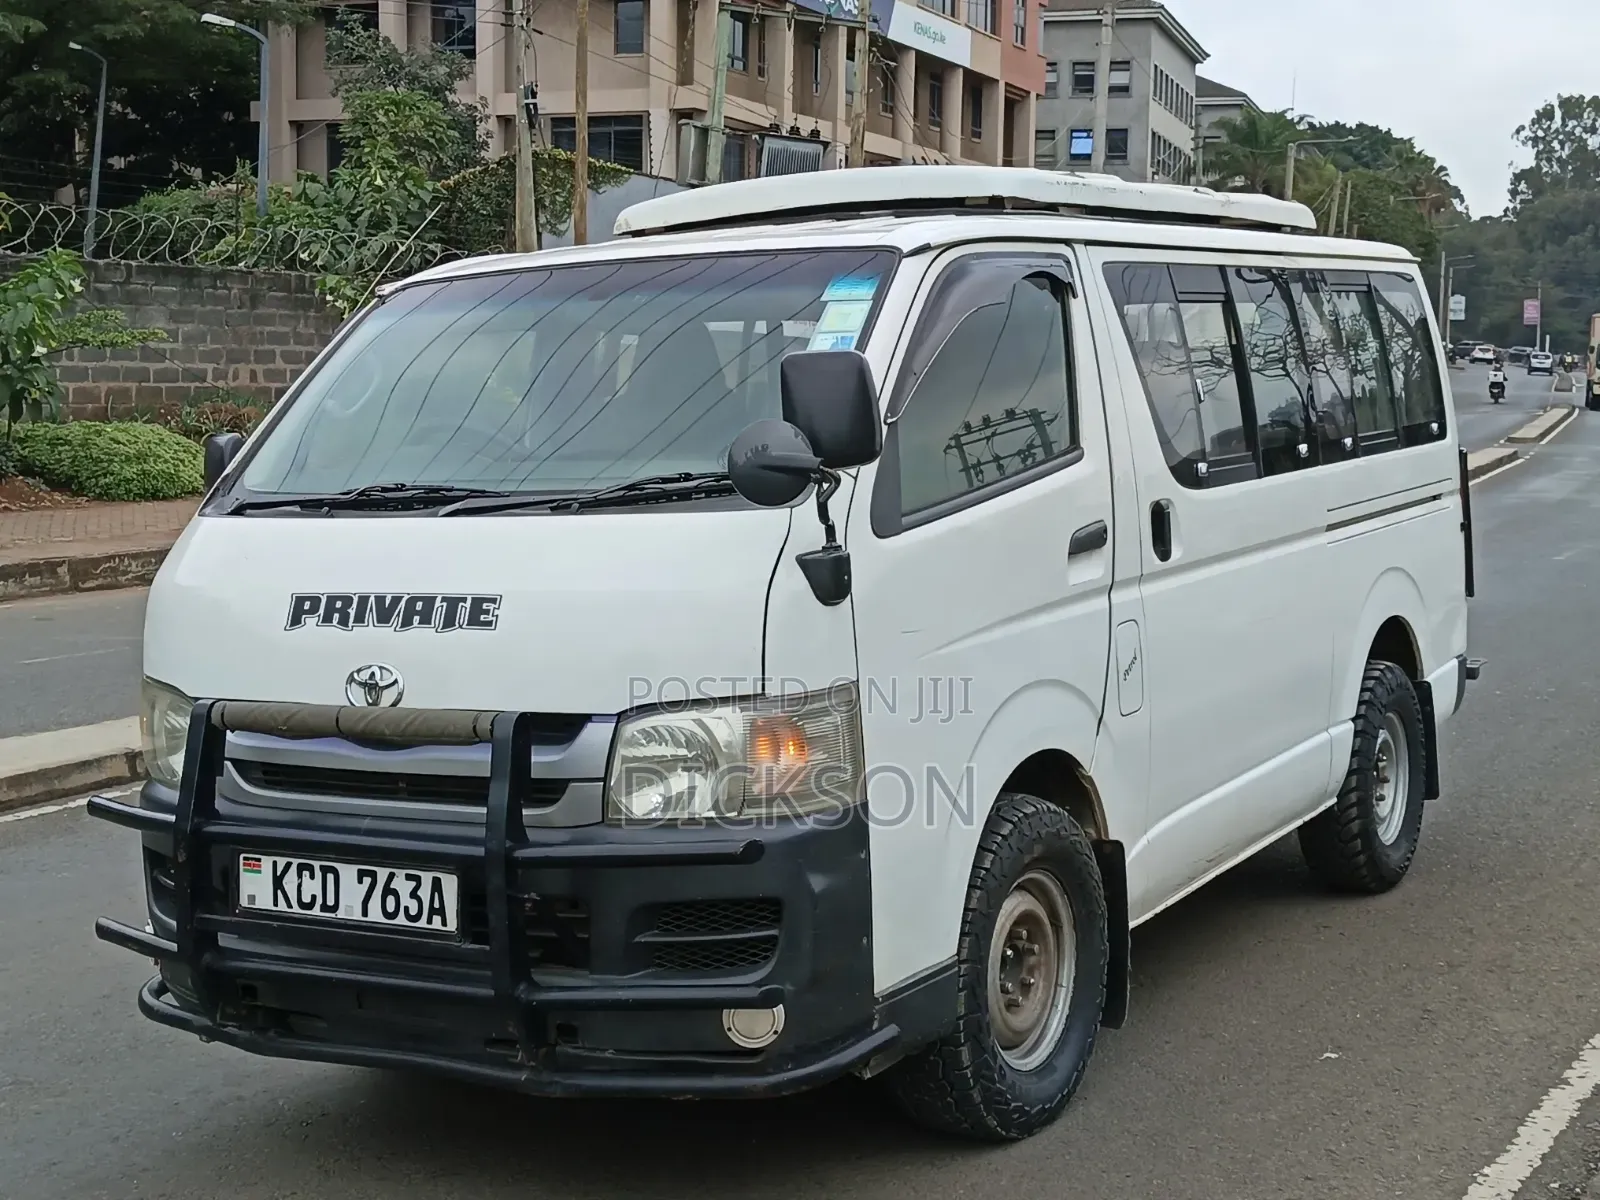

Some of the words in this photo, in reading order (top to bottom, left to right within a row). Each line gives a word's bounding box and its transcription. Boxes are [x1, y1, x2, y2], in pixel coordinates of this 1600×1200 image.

[284, 592, 503, 633] PRIVATE
[272, 860, 341, 914] KCD
[357, 868, 448, 928] 763A
